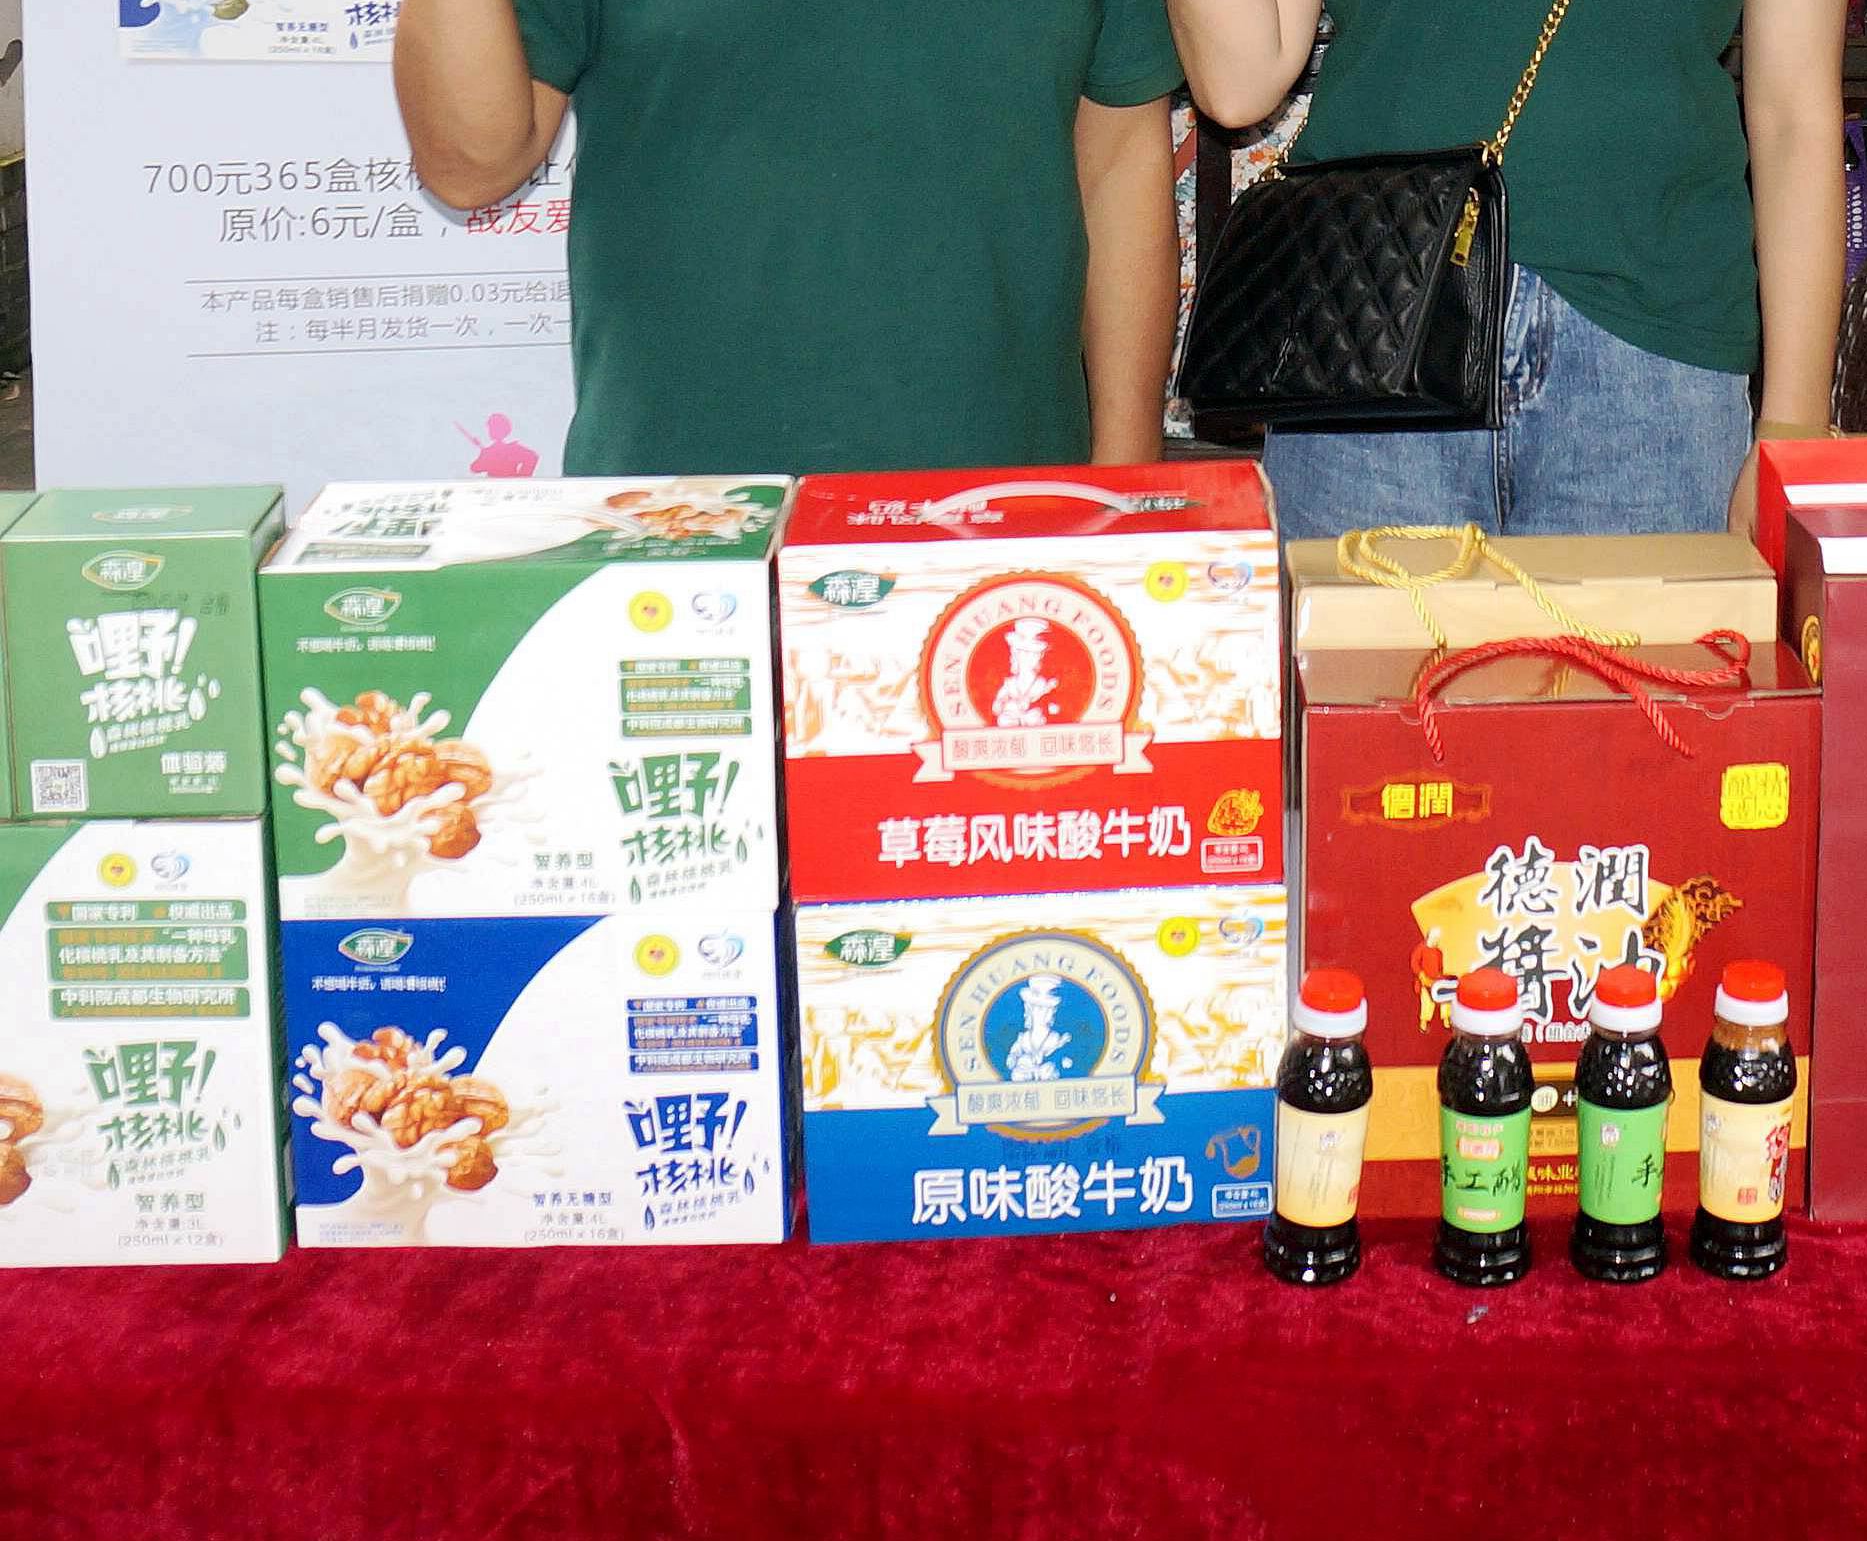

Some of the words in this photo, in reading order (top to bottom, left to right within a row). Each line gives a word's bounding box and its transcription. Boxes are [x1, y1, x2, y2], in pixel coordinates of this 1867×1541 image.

[1068, 606, 1122, 713] FOODS
[876, 804, 1193, 869] 草莓风味酸牛奶
[971, 950, 1075, 1005] HUANG
[1083, 963, 1135, 1066] FOODS
[912, 1155, 1194, 1226] 原味酸牛奶
